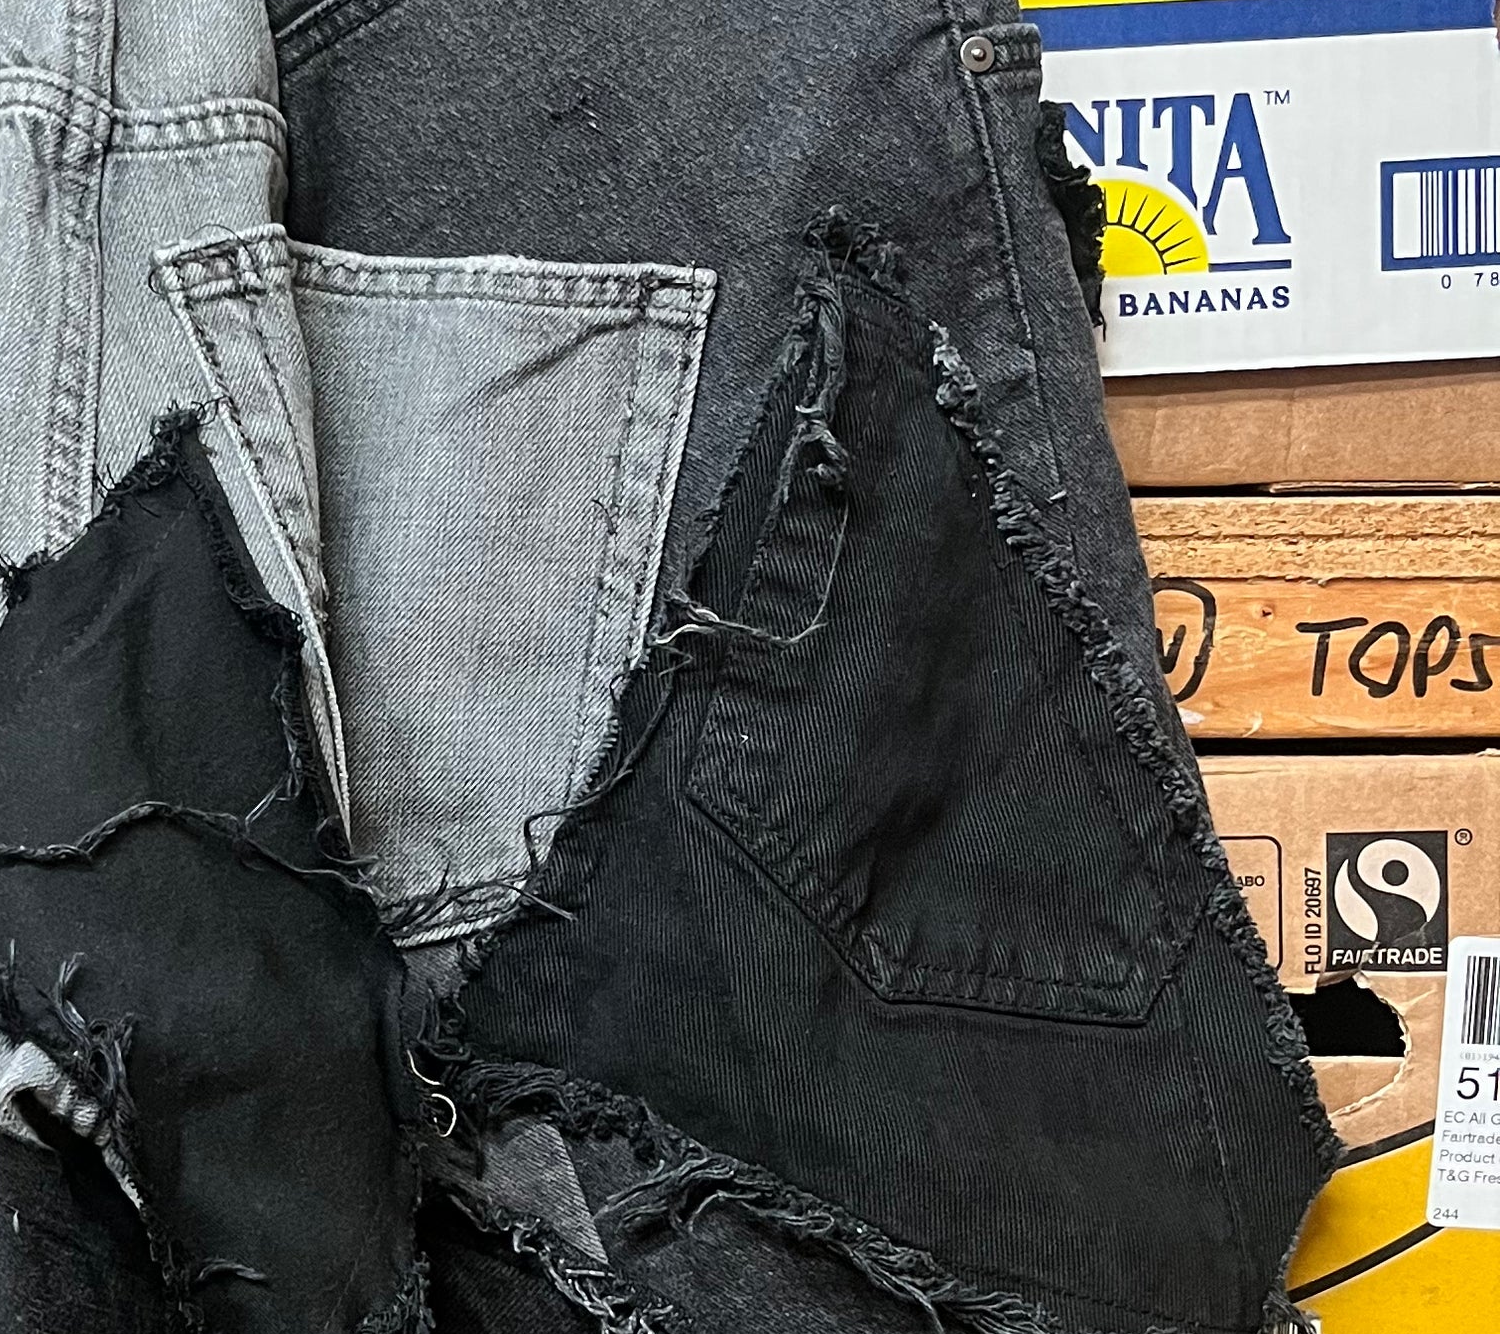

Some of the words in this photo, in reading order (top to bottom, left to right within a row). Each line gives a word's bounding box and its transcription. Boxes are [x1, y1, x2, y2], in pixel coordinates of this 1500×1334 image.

[1118, 285, 1290, 317] BANANAS
[1295, 615, 1500, 699] TOPS
[1304, 867, 1322, 919] 20697
[1304, 923, 1322, 939] ID
[1304, 943, 1322, 974] FLO
[1444, 1110, 1466, 1124] EC
[1469, 1111, 1486, 1124] All
[1439, 1150, 1495, 1165] Product
[1437, 1168, 1470, 1182] T&G
[1433, 1208, 1459, 1220] 244
